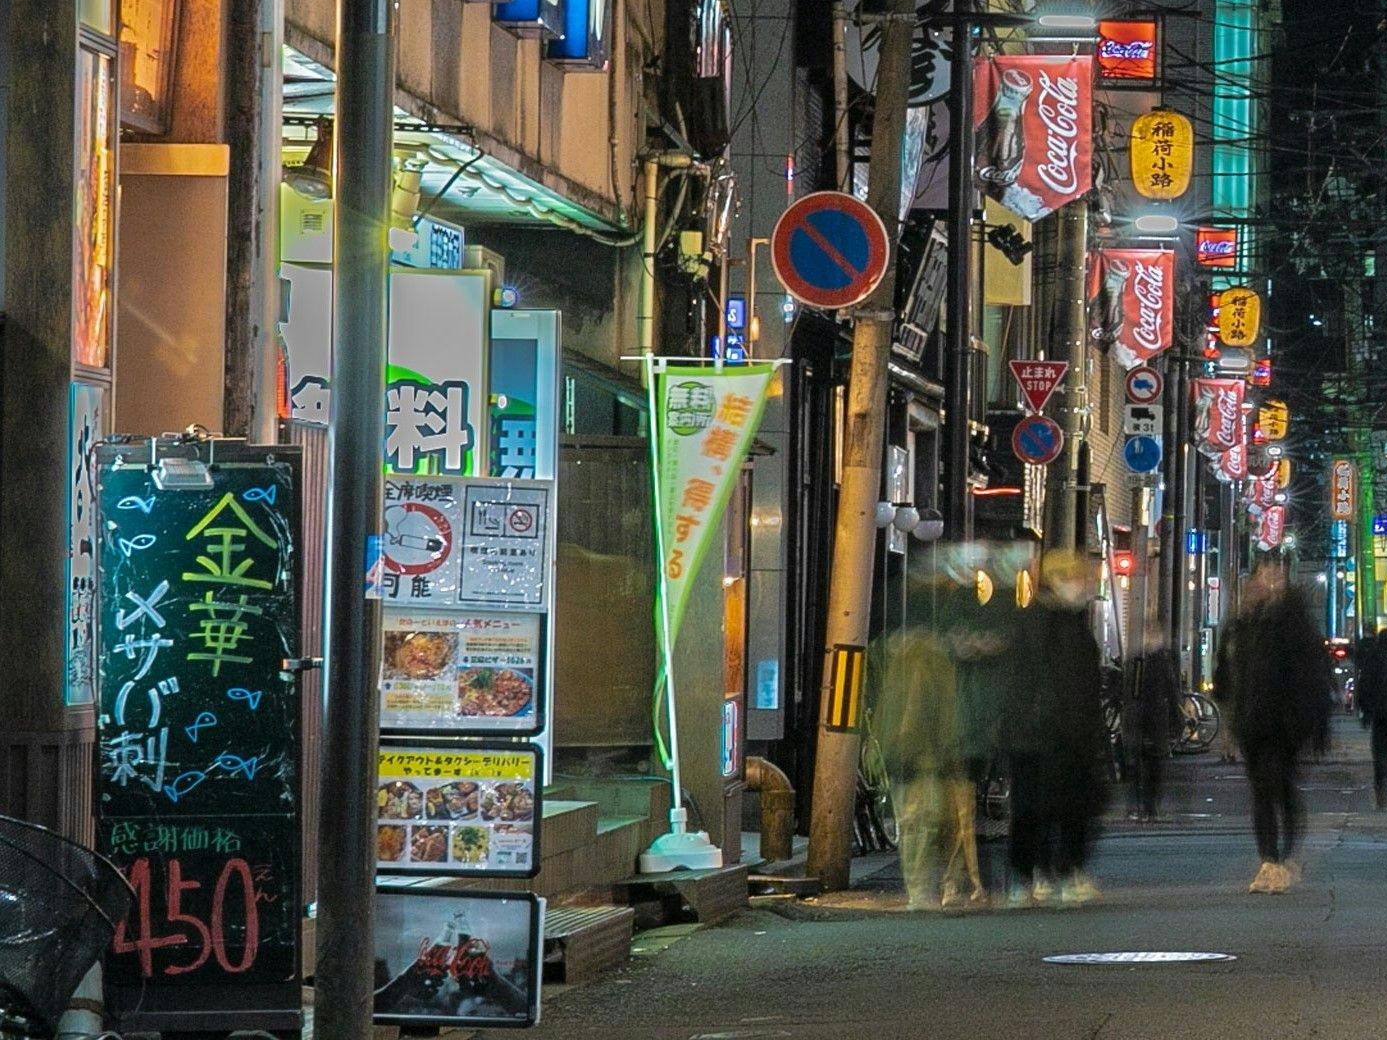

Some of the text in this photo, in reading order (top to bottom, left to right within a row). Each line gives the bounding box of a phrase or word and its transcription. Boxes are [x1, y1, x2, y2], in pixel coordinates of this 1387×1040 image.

[1037, 70, 1079, 194] Coca-Cola
[1151, 121, 1175, 189] 稲荷小路
[1133, 260, 1164, 350] Coca-Cola
[1021, 368, 1056, 379] 止まれ
[1026, 380, 1051, 392] STOP
[1217, 387, 1238, 447] Coca-Cola
[183, 492, 277, 677] 金華
[114, 858, 257, 978] 450
